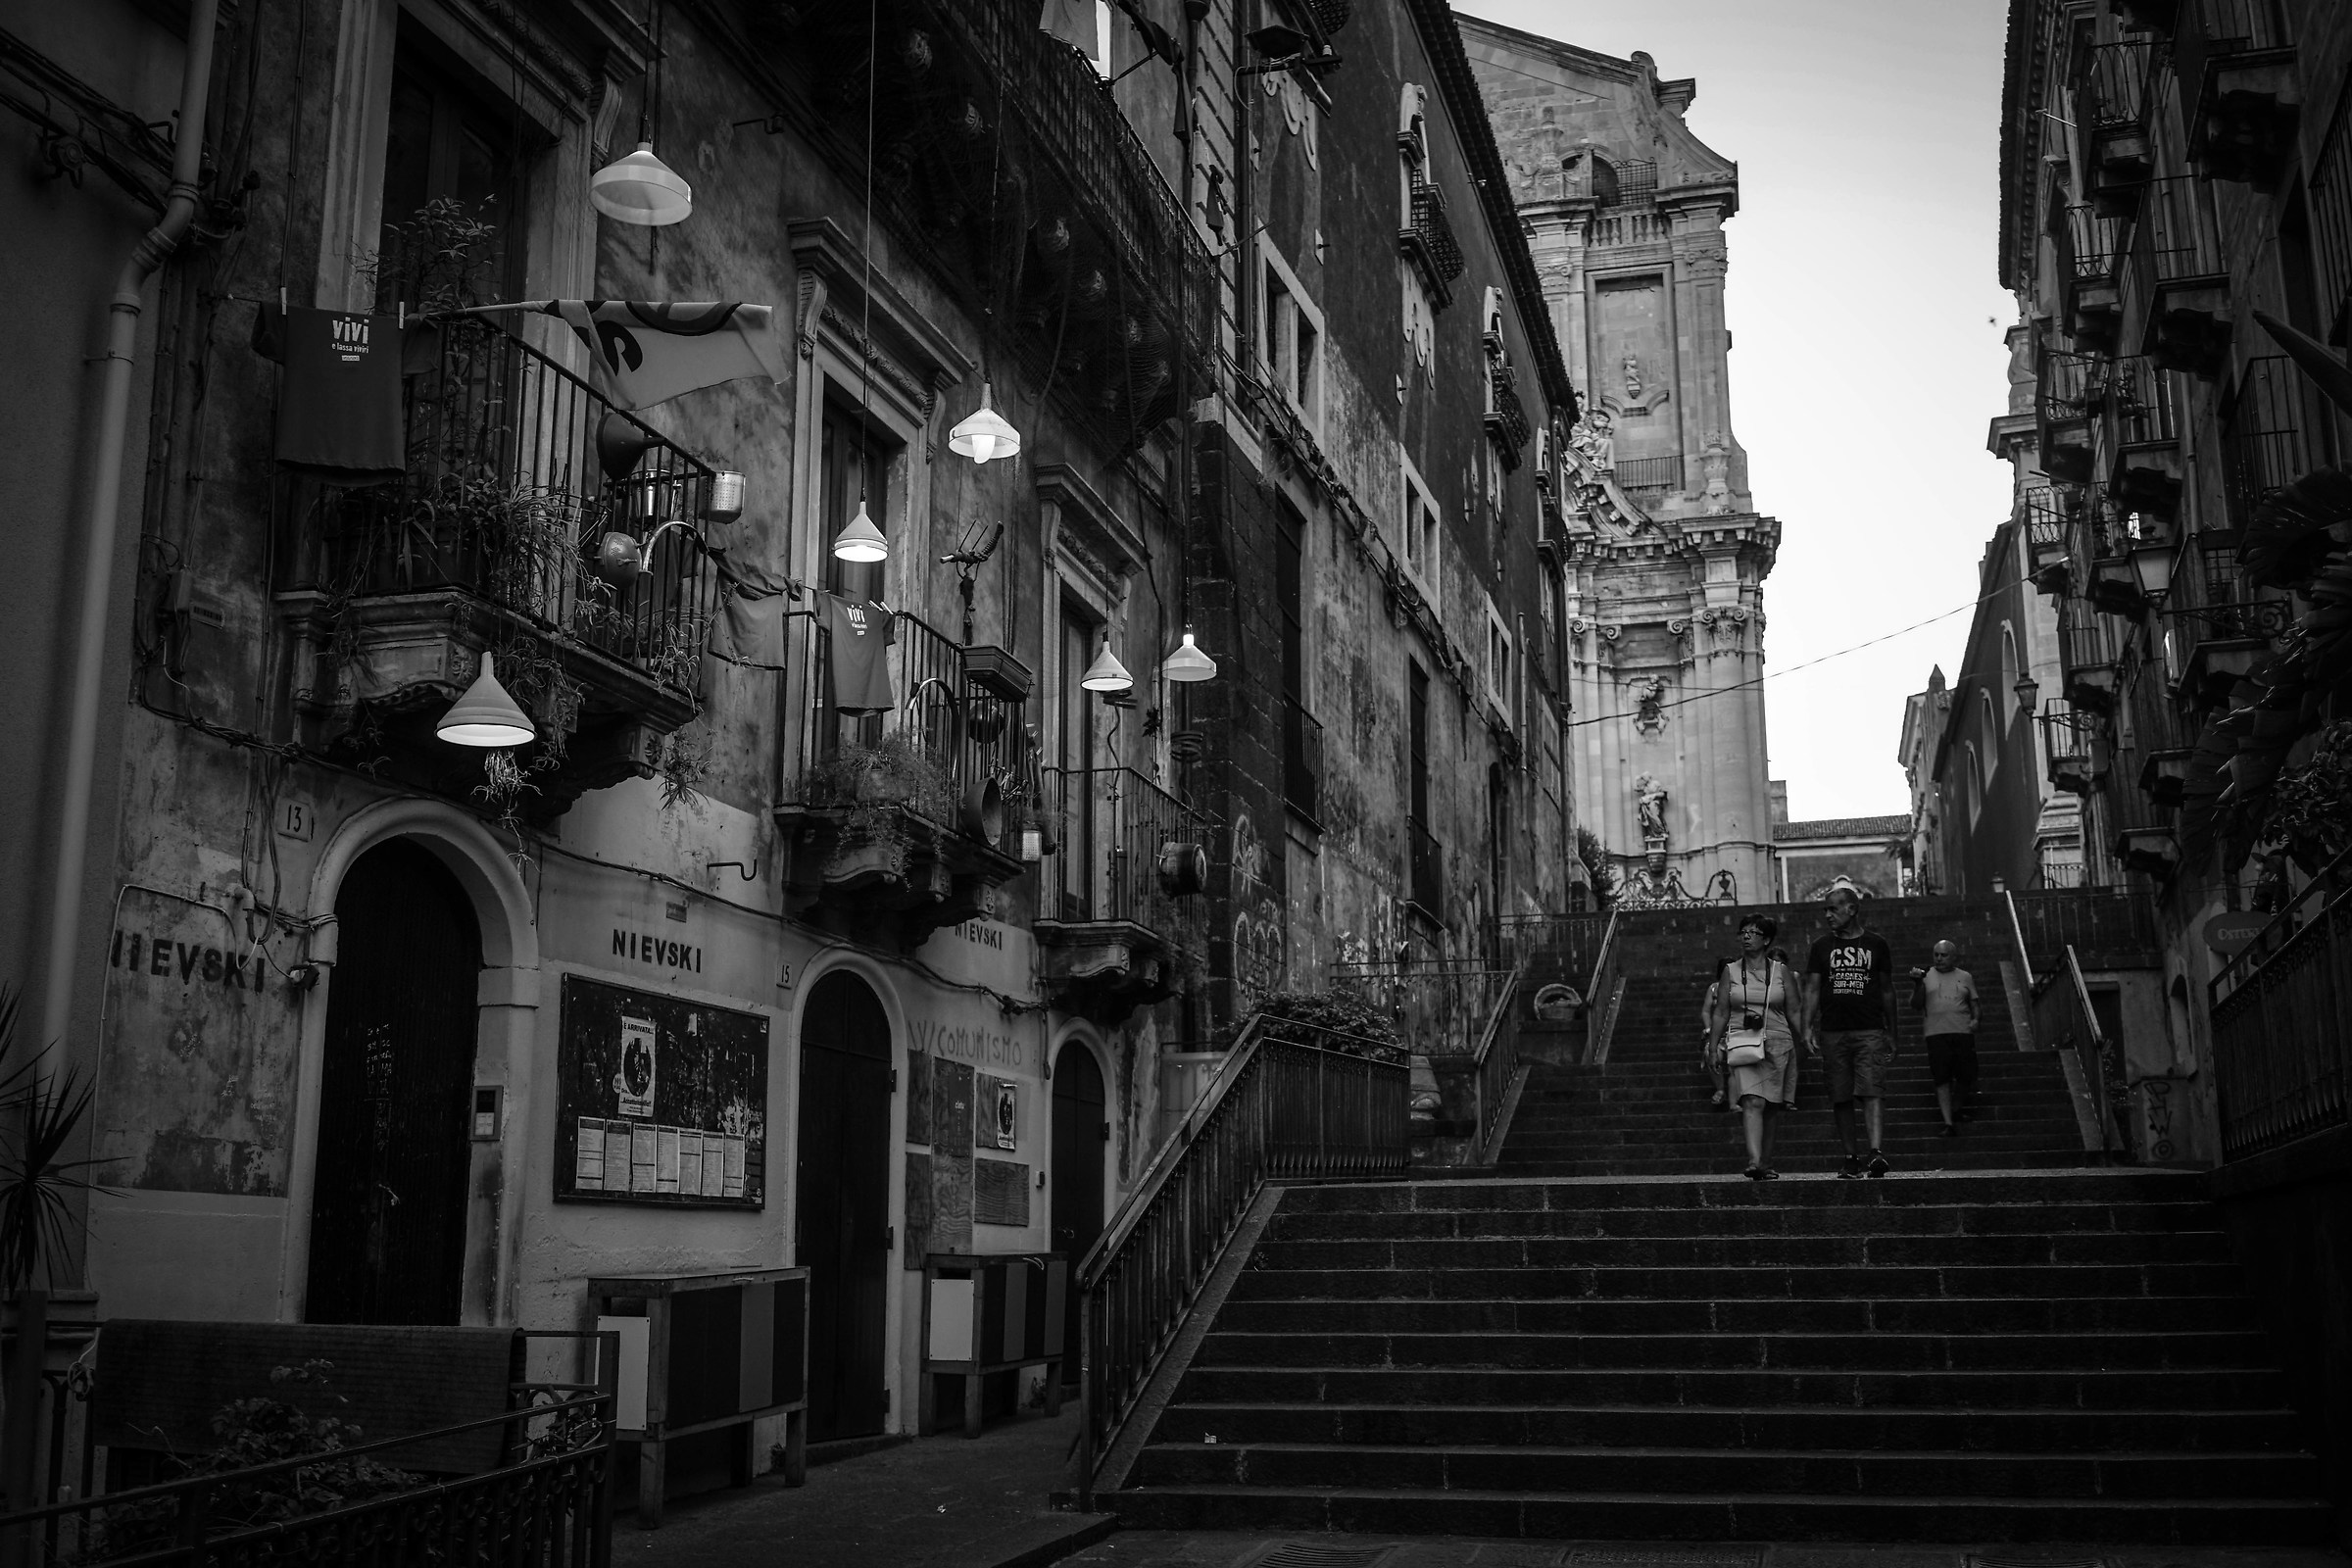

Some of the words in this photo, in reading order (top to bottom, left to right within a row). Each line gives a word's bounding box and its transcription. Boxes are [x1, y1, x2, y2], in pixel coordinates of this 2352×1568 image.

[332, 317, 369, 344] vivi
[337, 342, 353, 352] lassa
[287, 805, 302, 832] 13
[956, 922, 1002, 951] NIEVSKI
[612, 929, 702, 973] NIEVSKI
[781, 965, 790, 983] 15
[938, 1025, 1022, 1066] COMUNISMO
